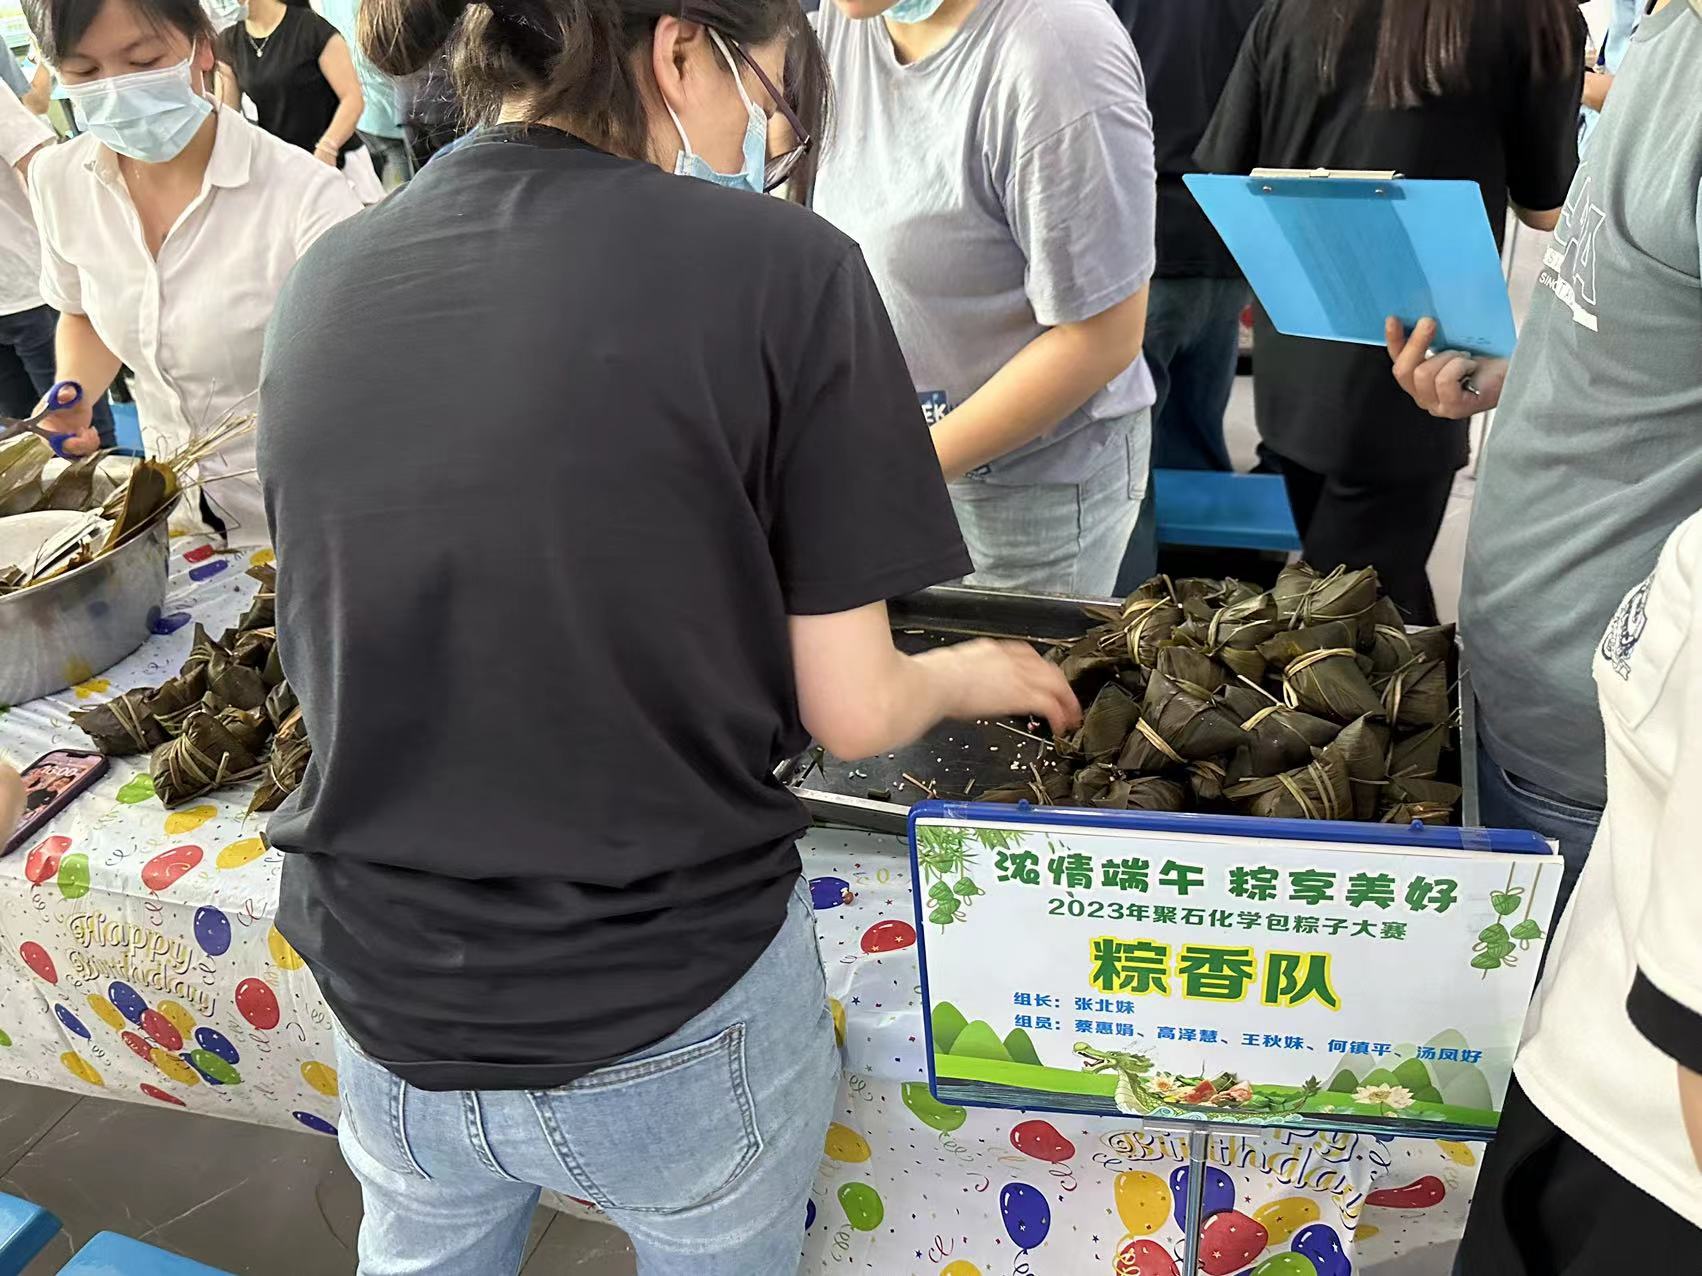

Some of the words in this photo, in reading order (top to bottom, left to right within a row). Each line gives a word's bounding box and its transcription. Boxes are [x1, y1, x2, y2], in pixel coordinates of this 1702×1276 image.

[994, 850, 1205, 896] 浓情端午
[1228, 865, 1458, 914] 粽享美好
[68, 911, 193, 976] Happy
[1047, 898, 1408, 941] 2023年聚石化学包粽子大赛
[68, 949, 216, 1018] Birthday
[1091, 936, 1340, 1010] 粽香队
[1101, 1129, 1363, 1231] Bithday
